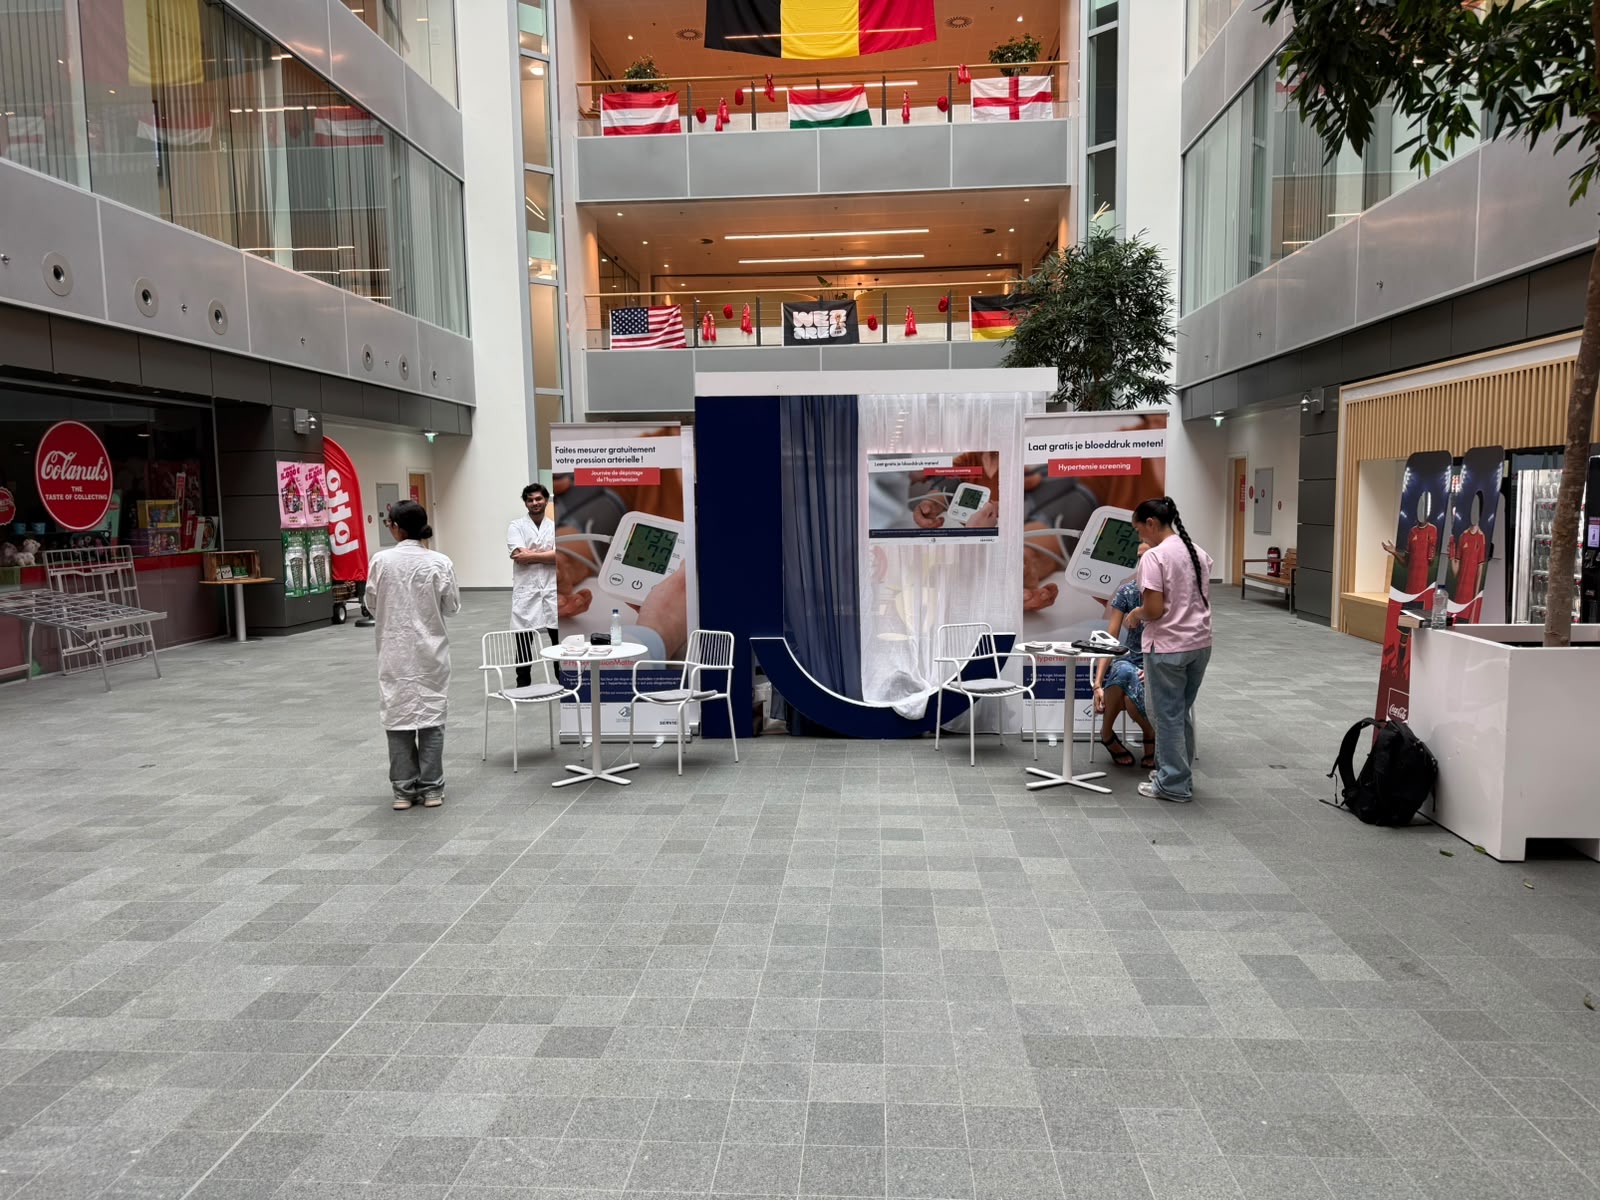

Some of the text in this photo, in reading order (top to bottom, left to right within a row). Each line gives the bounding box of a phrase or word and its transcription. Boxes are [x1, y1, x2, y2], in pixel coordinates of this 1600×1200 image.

[793, 311, 829, 327] WE
[555, 445, 656, 455] Faites mesurer gratuitement
[1028, 438, 1164, 453] Laat gratis je bloeddruk meten!
[41, 450, 108, 481] Colanuts
[555, 456, 575, 464] votre
[576, 455, 606, 465] pression
[607, 455, 640, 464] artérielle
[1058, 462, 1131, 472] Hypertensie screening
[644, 529, 675, 546] 134
[648, 543, 672, 561] 77
[648, 561, 666, 575] 78
